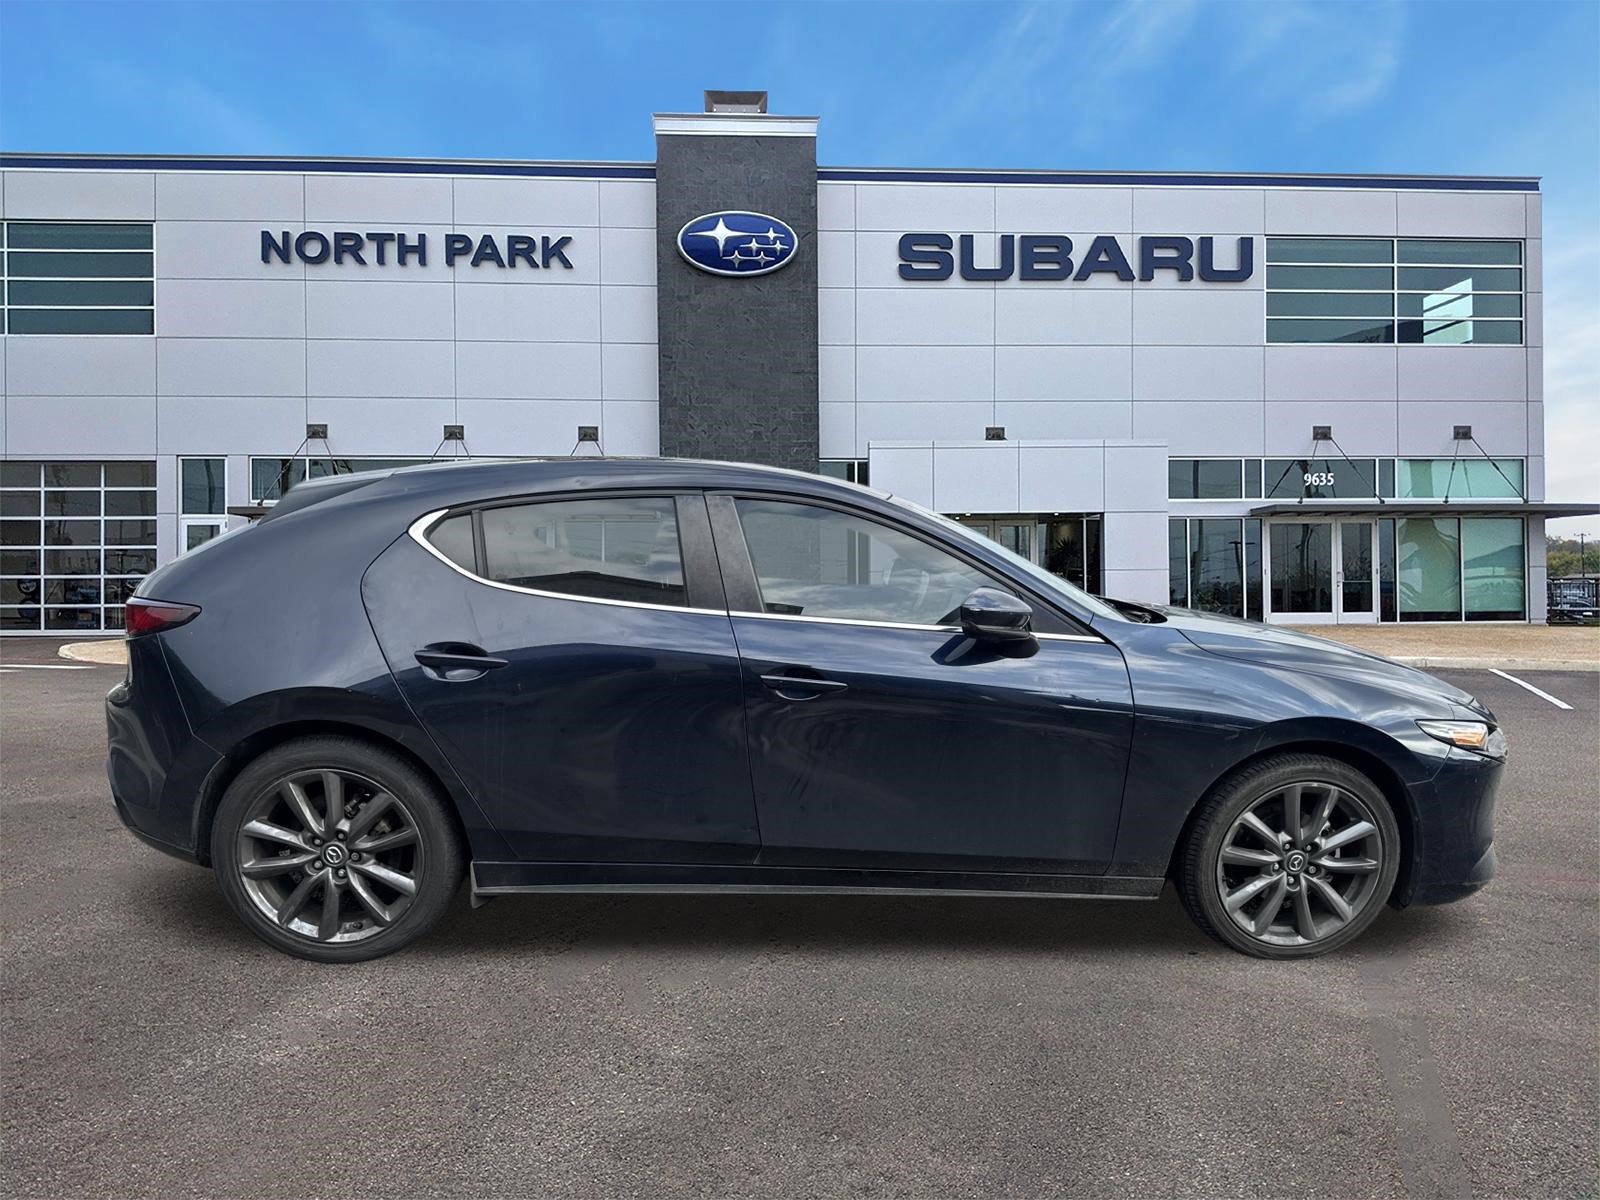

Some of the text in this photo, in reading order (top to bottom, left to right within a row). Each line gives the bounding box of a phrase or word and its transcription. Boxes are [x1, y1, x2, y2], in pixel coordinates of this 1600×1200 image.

[261, 230, 574, 269] NORTH PARK
[898, 233, 1253, 282] SUBARU
[1304, 472, 1334, 486] 9635
